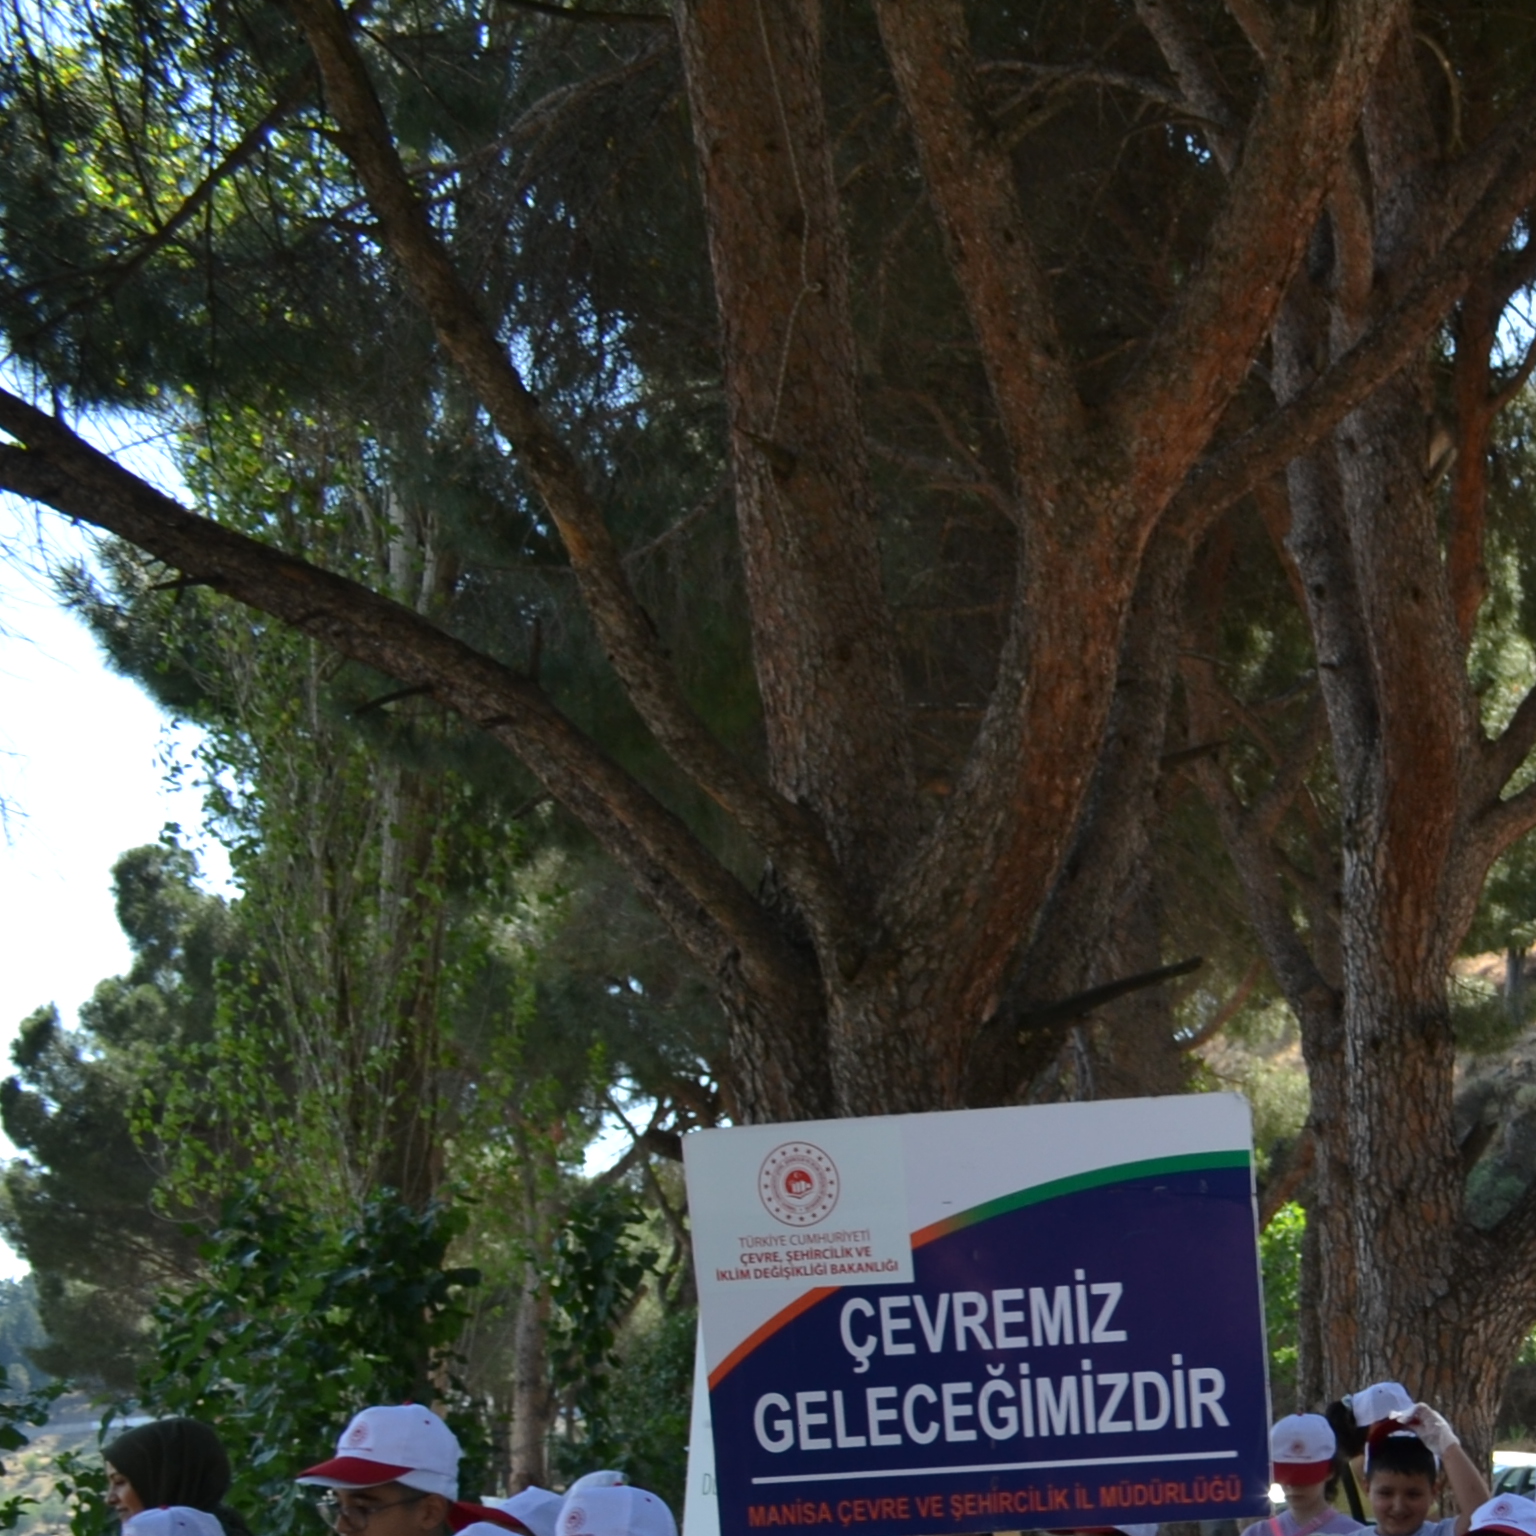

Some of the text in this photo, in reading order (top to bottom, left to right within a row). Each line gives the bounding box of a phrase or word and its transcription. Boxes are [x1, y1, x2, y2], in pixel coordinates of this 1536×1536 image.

[738, 1229, 871, 1249] TÜRKİYE CUMHURİYETİ
[739, 1246, 872, 1267] ÇEVRE, ŞEHİRCİLİK VE
[716, 1258, 899, 1282] İKLİM DEĞİŞİKLİĞİ BAKANLIĞI
[839, 1269, 1127, 1374] ÇEVREMİZ
[753, 1354, 1230, 1455] GELECEĞİMİZDİR
[748, 1475, 1242, 1528] MANİSA ÇEVRE VE ŞEHİRCİLİK İL MÜDÜRLÜĞÜ
